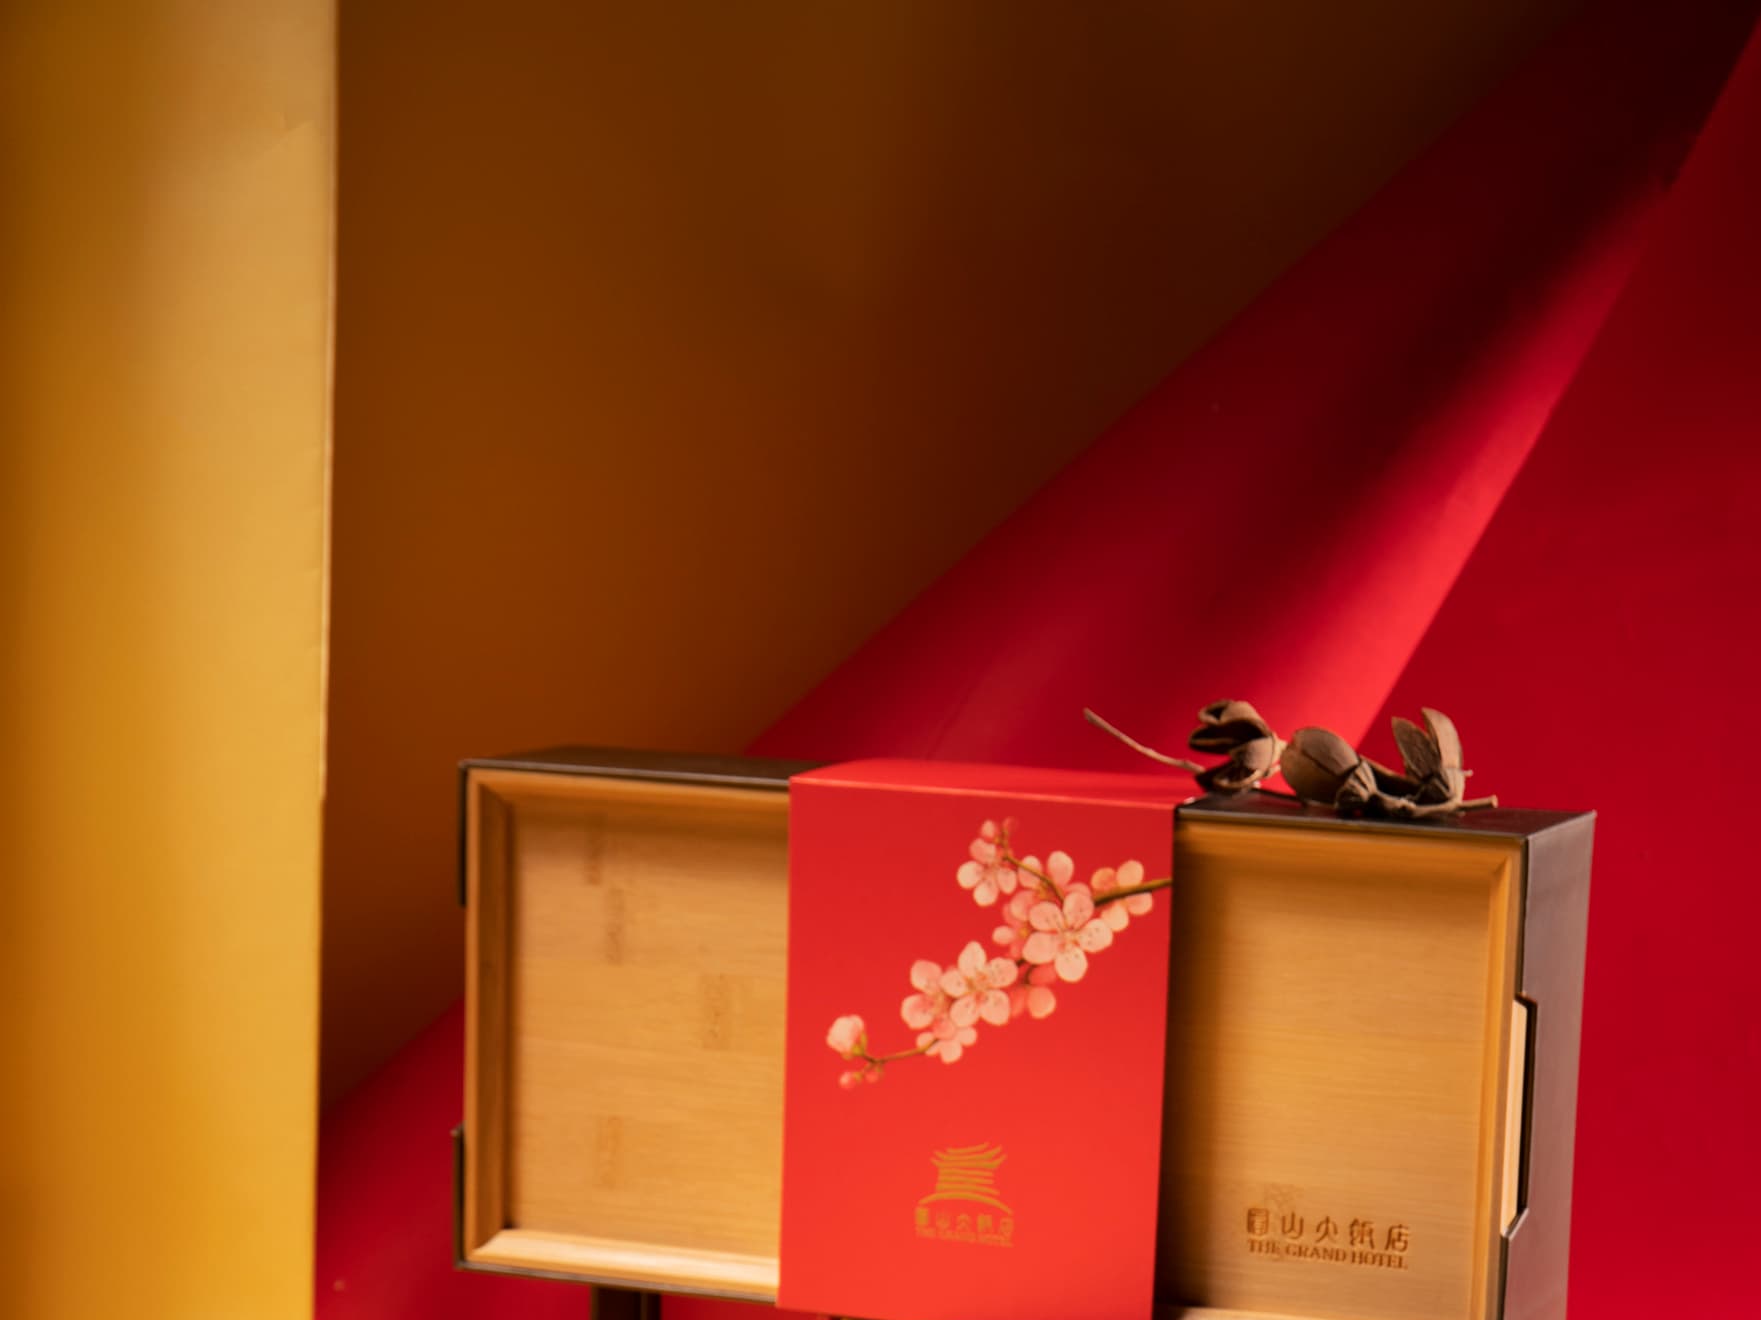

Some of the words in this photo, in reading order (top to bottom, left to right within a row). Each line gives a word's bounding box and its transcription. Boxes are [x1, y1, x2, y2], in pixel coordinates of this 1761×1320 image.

[1247, 1239, 1281, 1256] THE
[1285, 1244, 1348, 1263] GRAND
[1350, 1249, 1409, 1270] HOTEL
